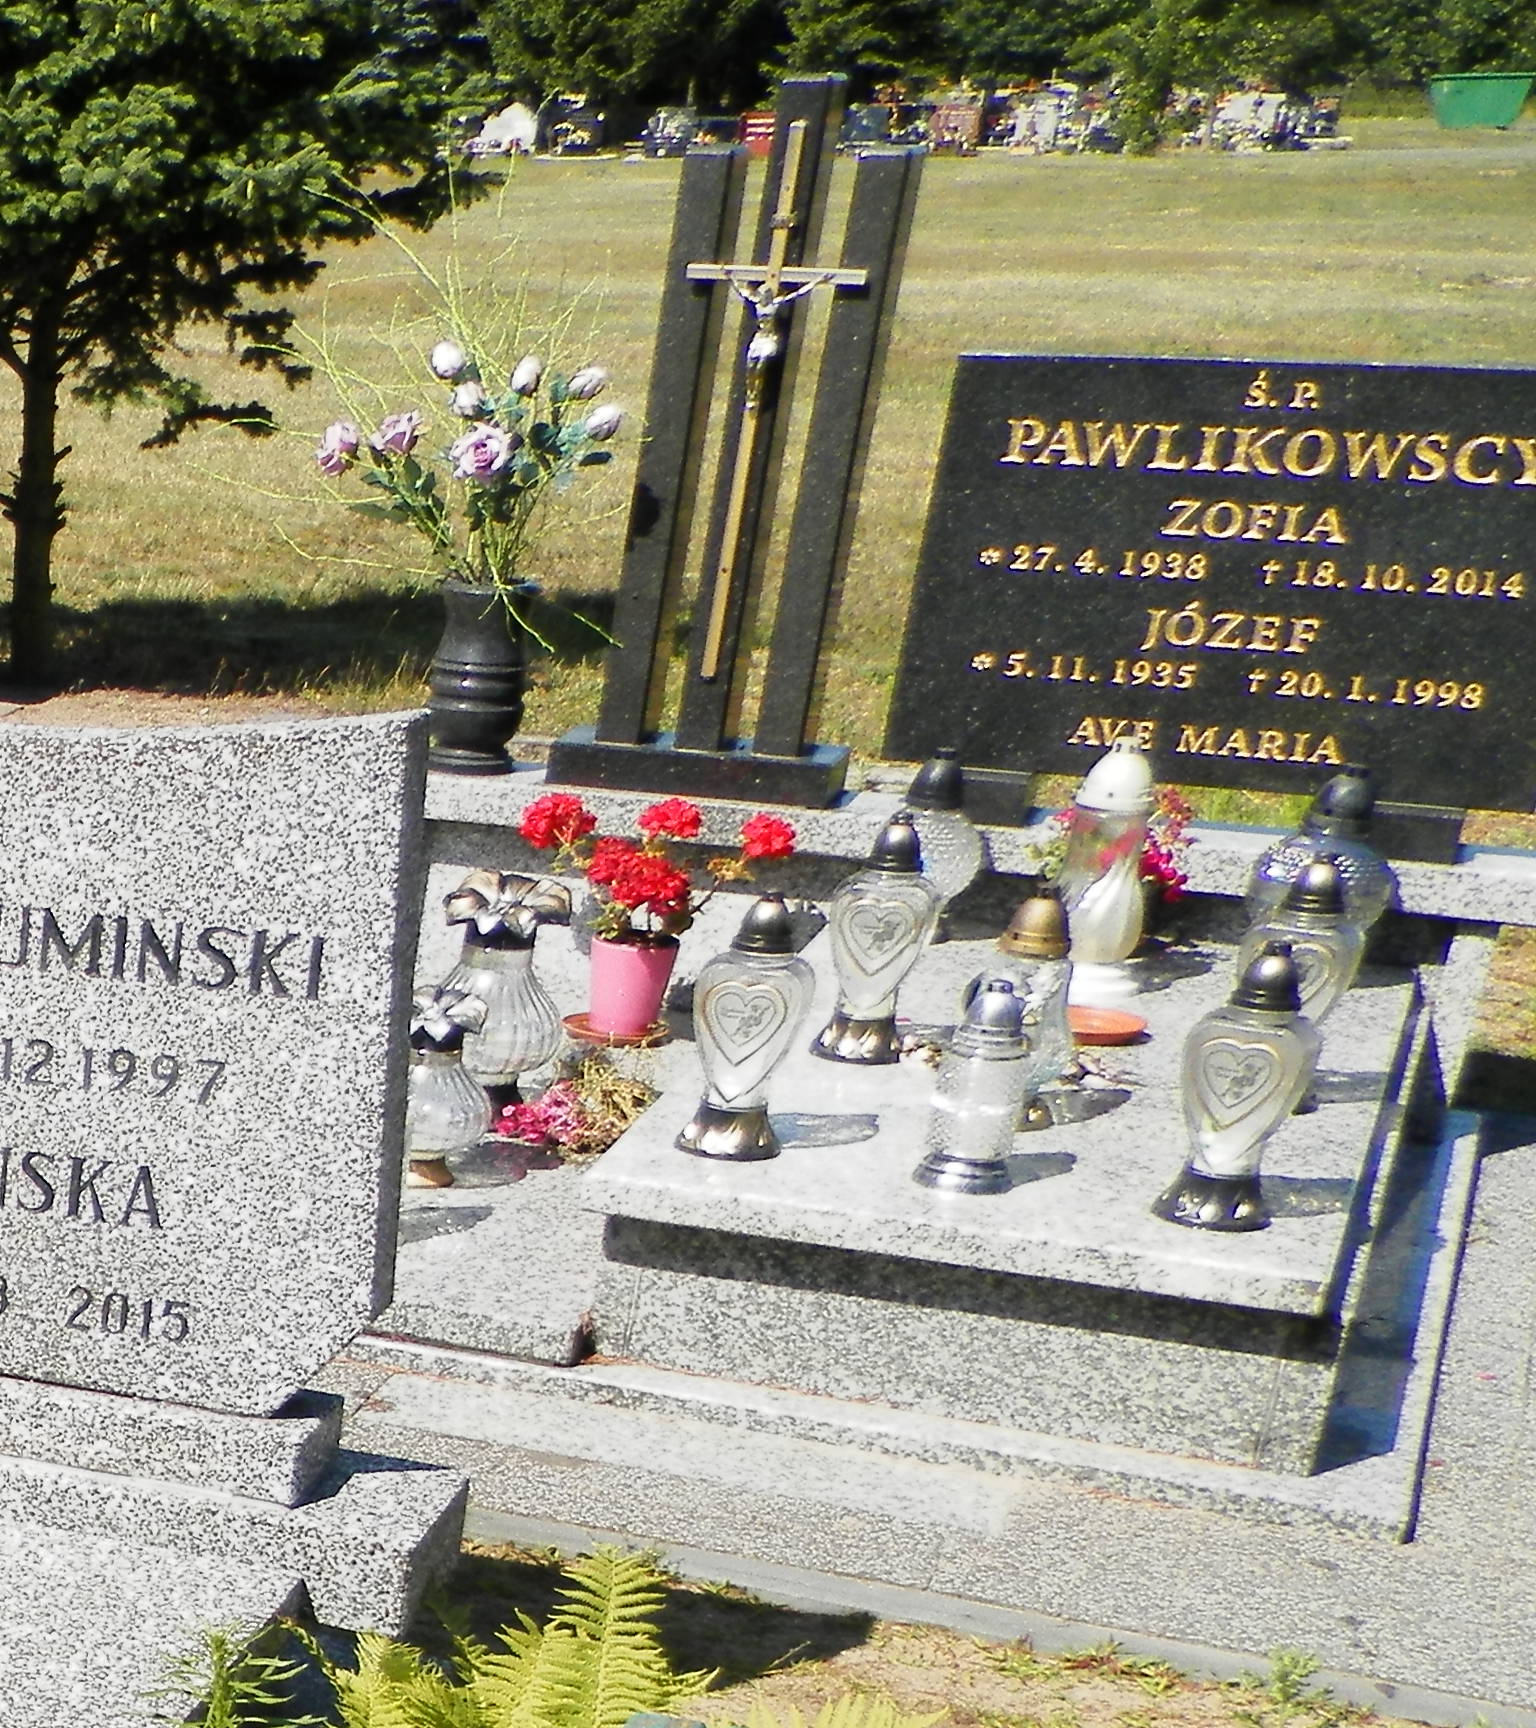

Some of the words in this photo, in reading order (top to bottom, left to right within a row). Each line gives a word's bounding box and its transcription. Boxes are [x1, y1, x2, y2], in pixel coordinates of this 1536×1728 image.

[999, 415, 1536, 486] PAWLIKOWSCY
[1159, 497, 1349, 546] ZOFIA
[1118, 550, 1210, 582] 1938
[1426, 565, 1525, 600] 2014
[1139, 600, 1325, 656] JÓZEF
[1111, 658, 1199, 690] 1935
[1391, 676, 1487, 711] 1998
[1066, 716, 1157, 751] AVE
[1175, 723, 1345, 766] MARIA
[64, 1284, 192, 1344] 2015
